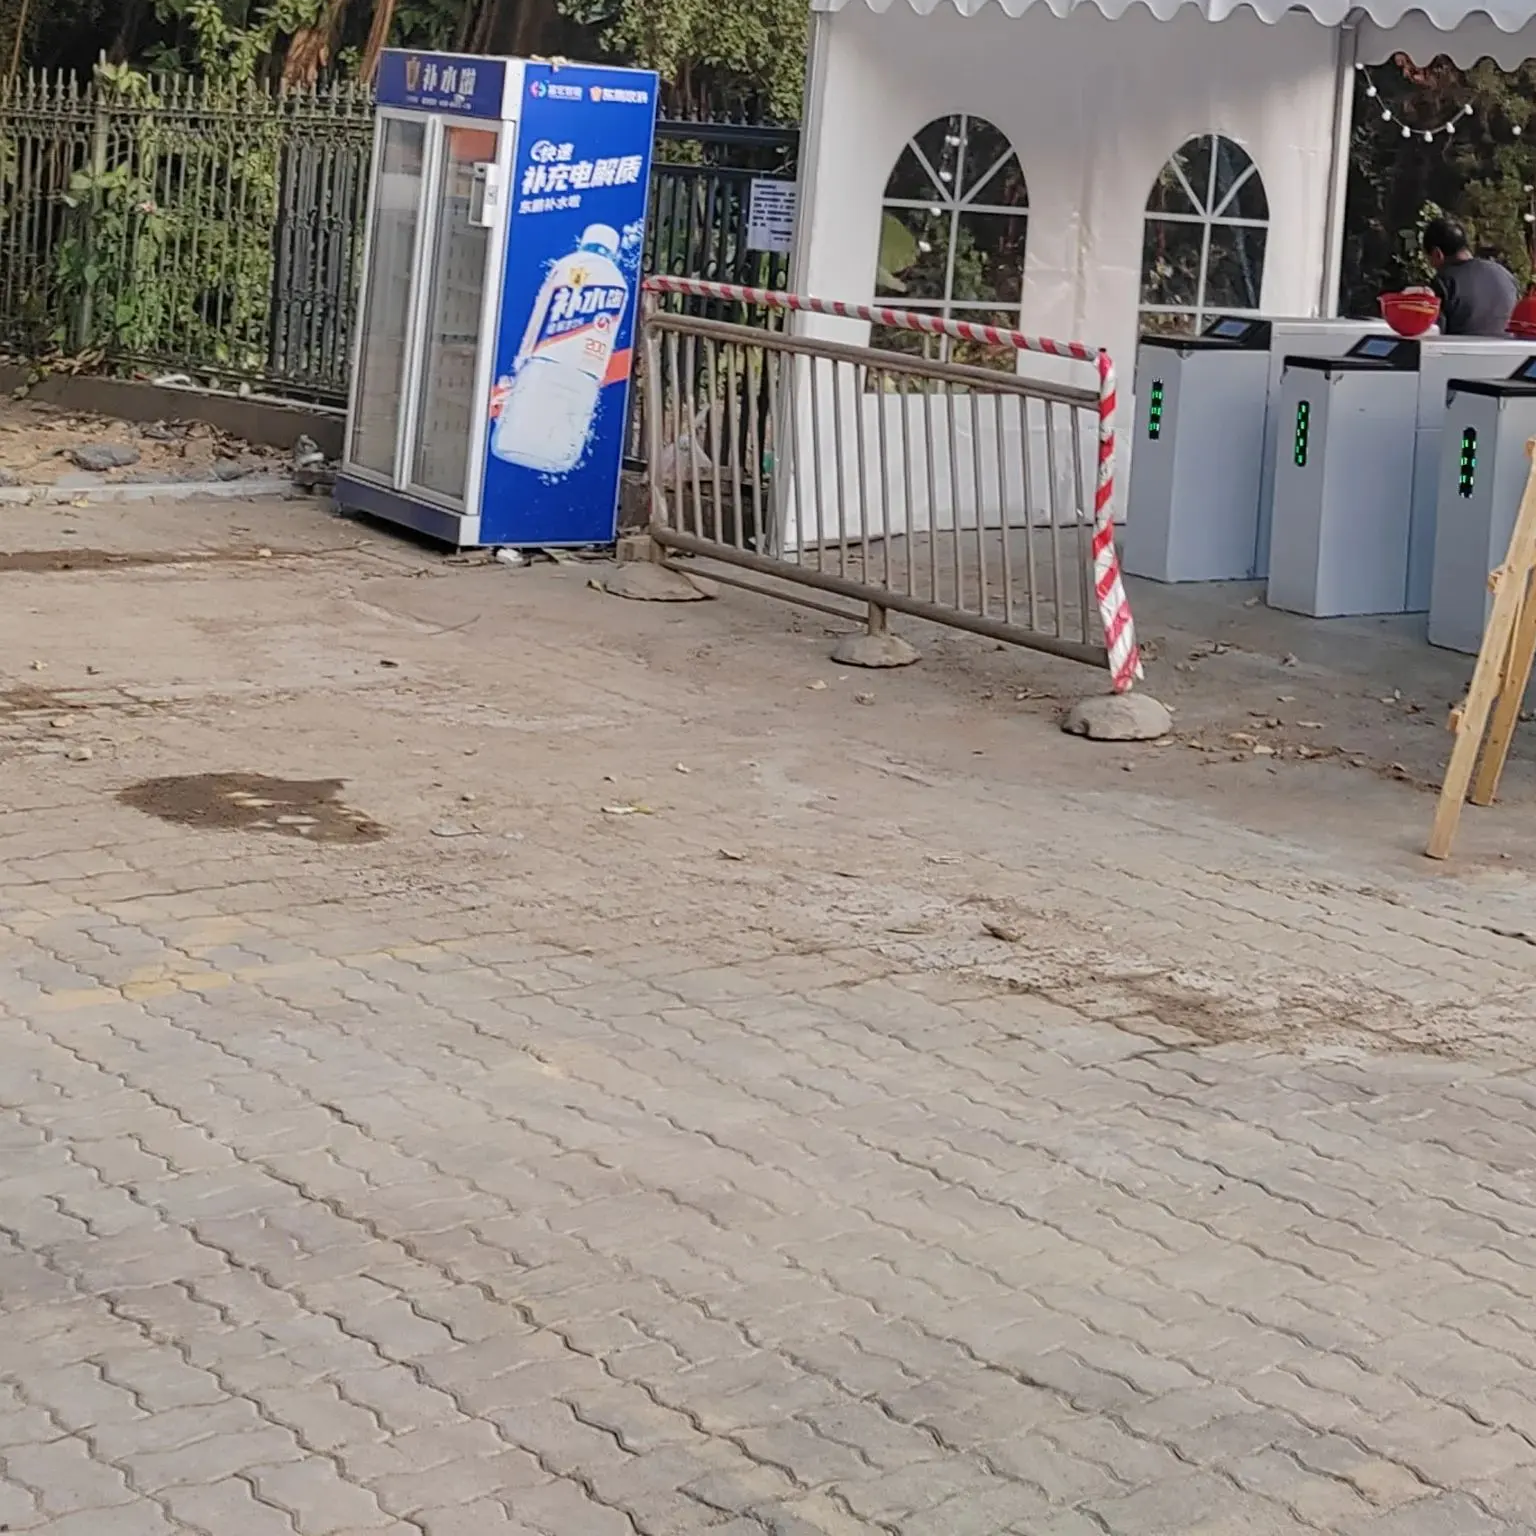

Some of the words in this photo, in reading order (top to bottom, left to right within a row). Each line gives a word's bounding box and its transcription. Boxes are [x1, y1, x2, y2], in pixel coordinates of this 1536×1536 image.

[521, 155, 643, 196] 补充电解质
